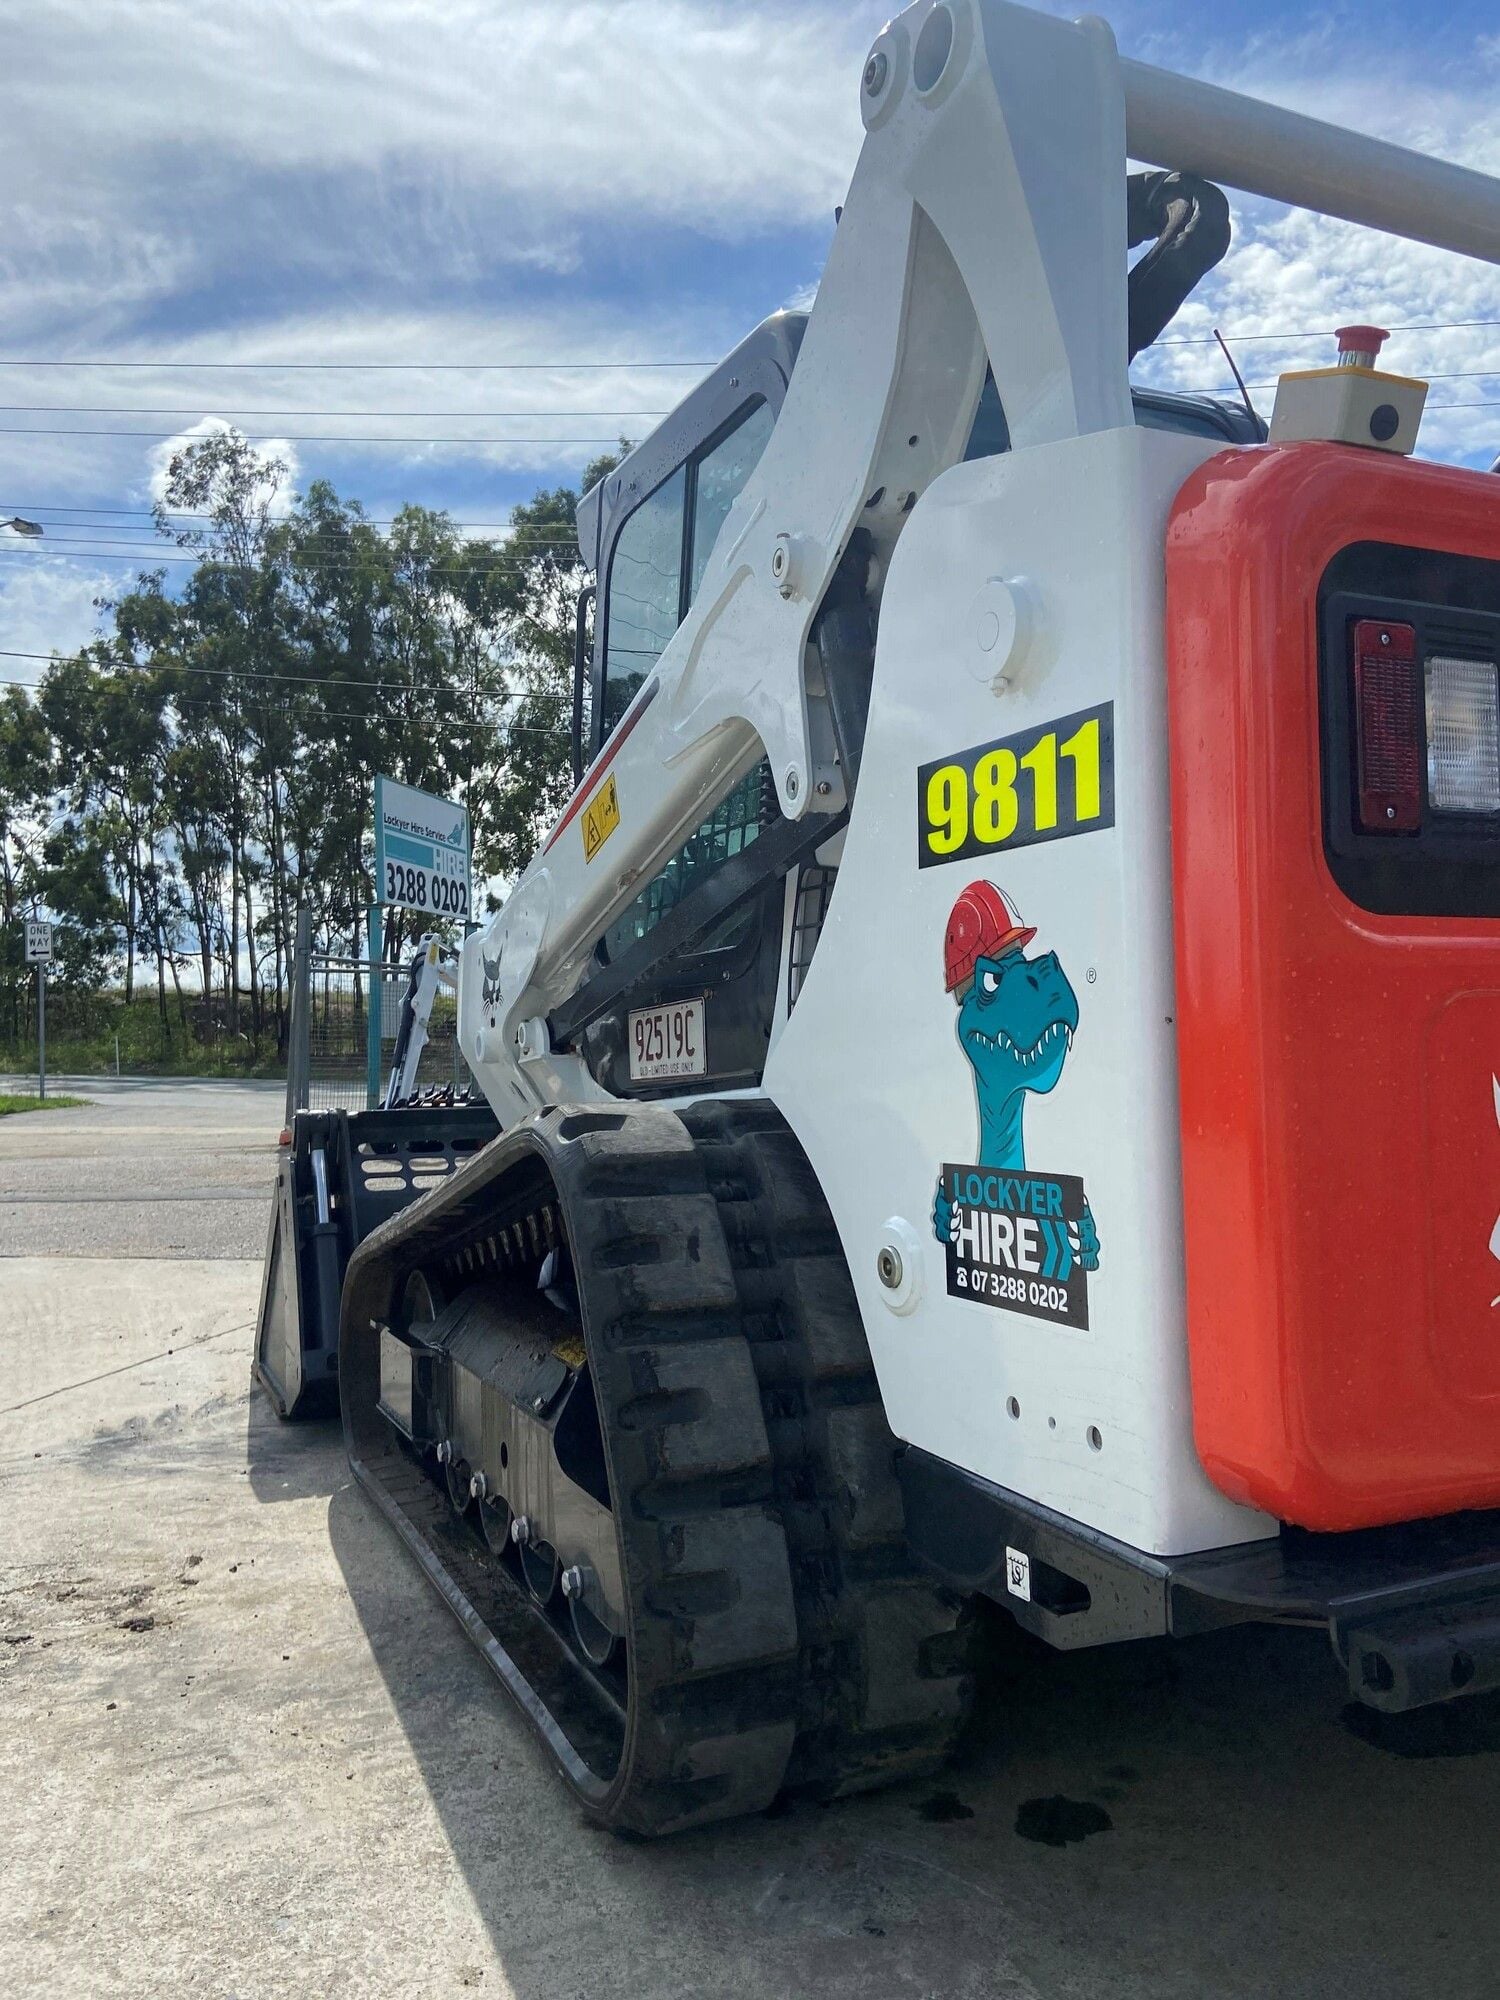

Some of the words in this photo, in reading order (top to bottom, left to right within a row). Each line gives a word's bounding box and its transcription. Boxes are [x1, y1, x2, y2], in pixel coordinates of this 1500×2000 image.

[926, 718, 1100, 855] 9811
[384, 812, 409, 830] Lockyer
[411, 822, 424, 835] Hire
[426, 827, 446, 842] Service
[434, 848, 465, 876] HIRE
[387, 862, 426, 906] 3288
[431, 875, 468, 915] 0202
[29, 938, 49, 947] WAY
[30, 926, 48, 935] ONE
[635, 1009, 695, 1062] 92519C
[953, 1172, 1063, 1218] LOCKYER
[956, 1208, 1041, 1274] HIRE
[971, 1269, 989, 1293] 07
[991, 1273, 1027, 1302] 3288
[1029, 1282, 1069, 1313] 0202
